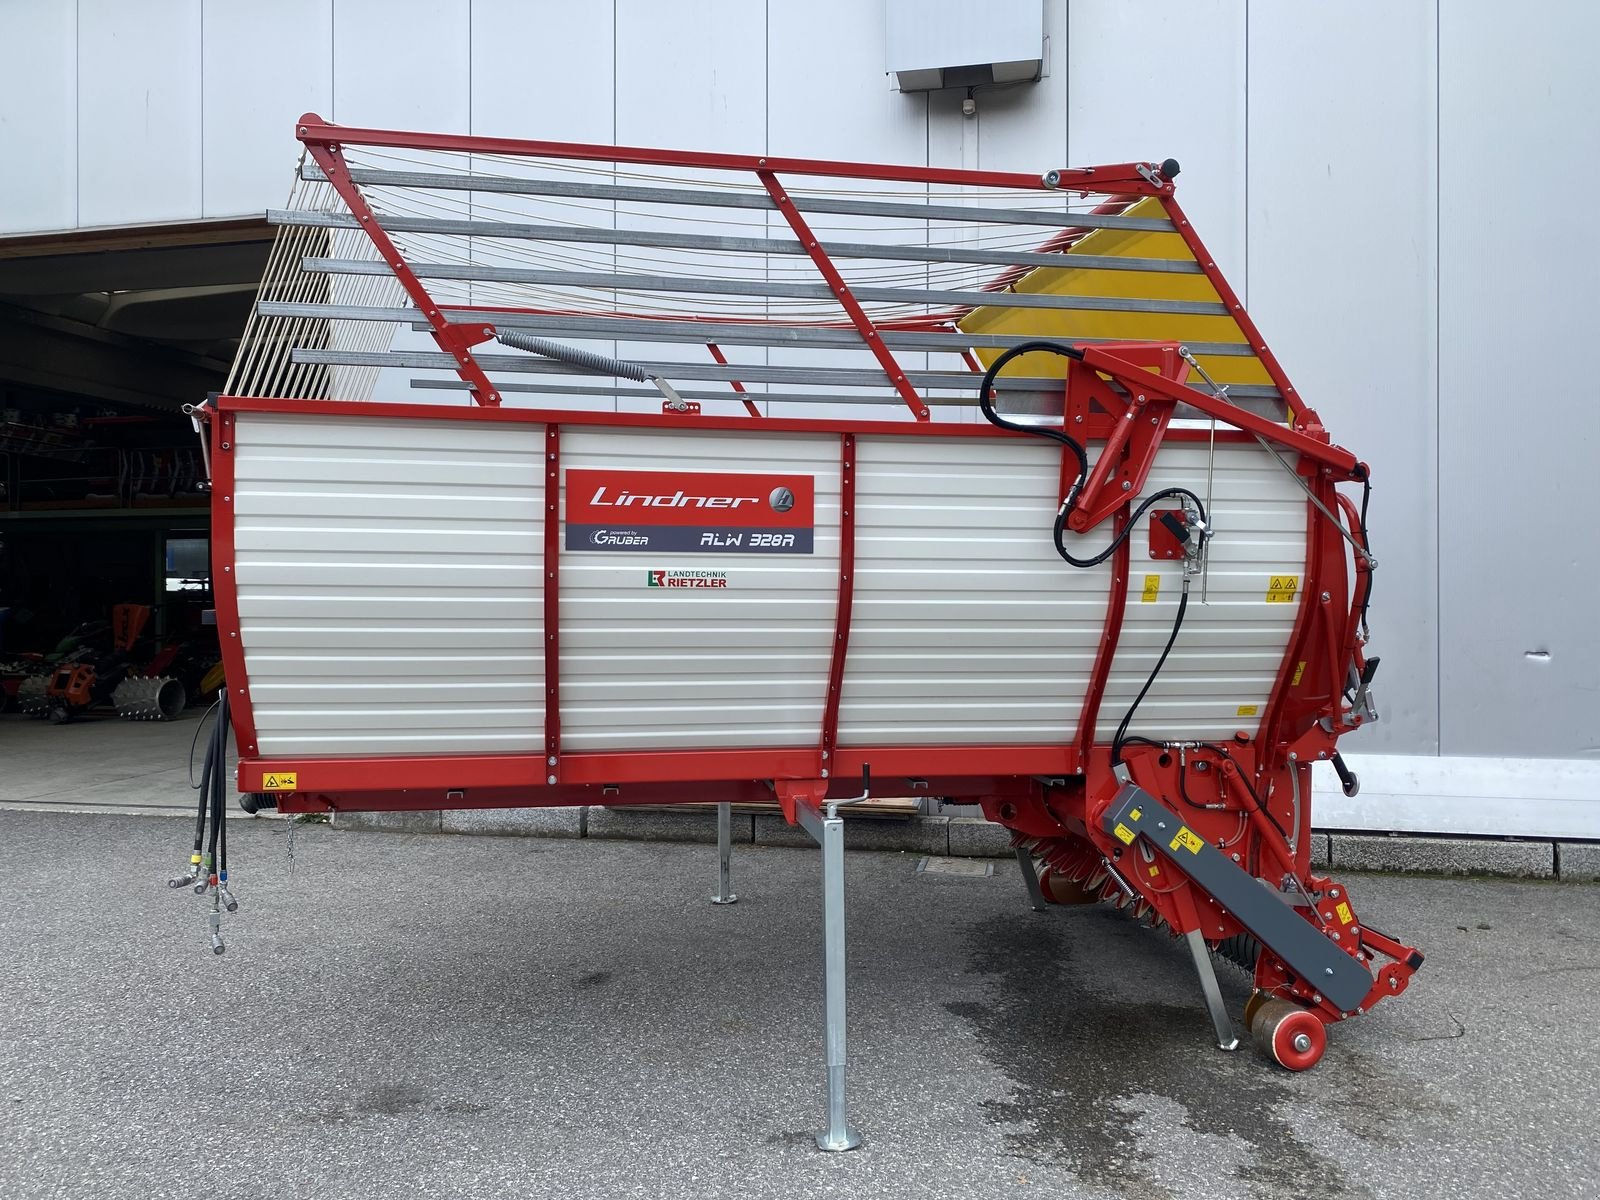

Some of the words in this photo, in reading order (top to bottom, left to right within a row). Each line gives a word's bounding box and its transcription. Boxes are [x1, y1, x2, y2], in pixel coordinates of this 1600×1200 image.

[590, 486, 759, 509] Lindner
[594, 530, 649, 546] GRUBER
[668, 578, 727, 587] RIETZLER
